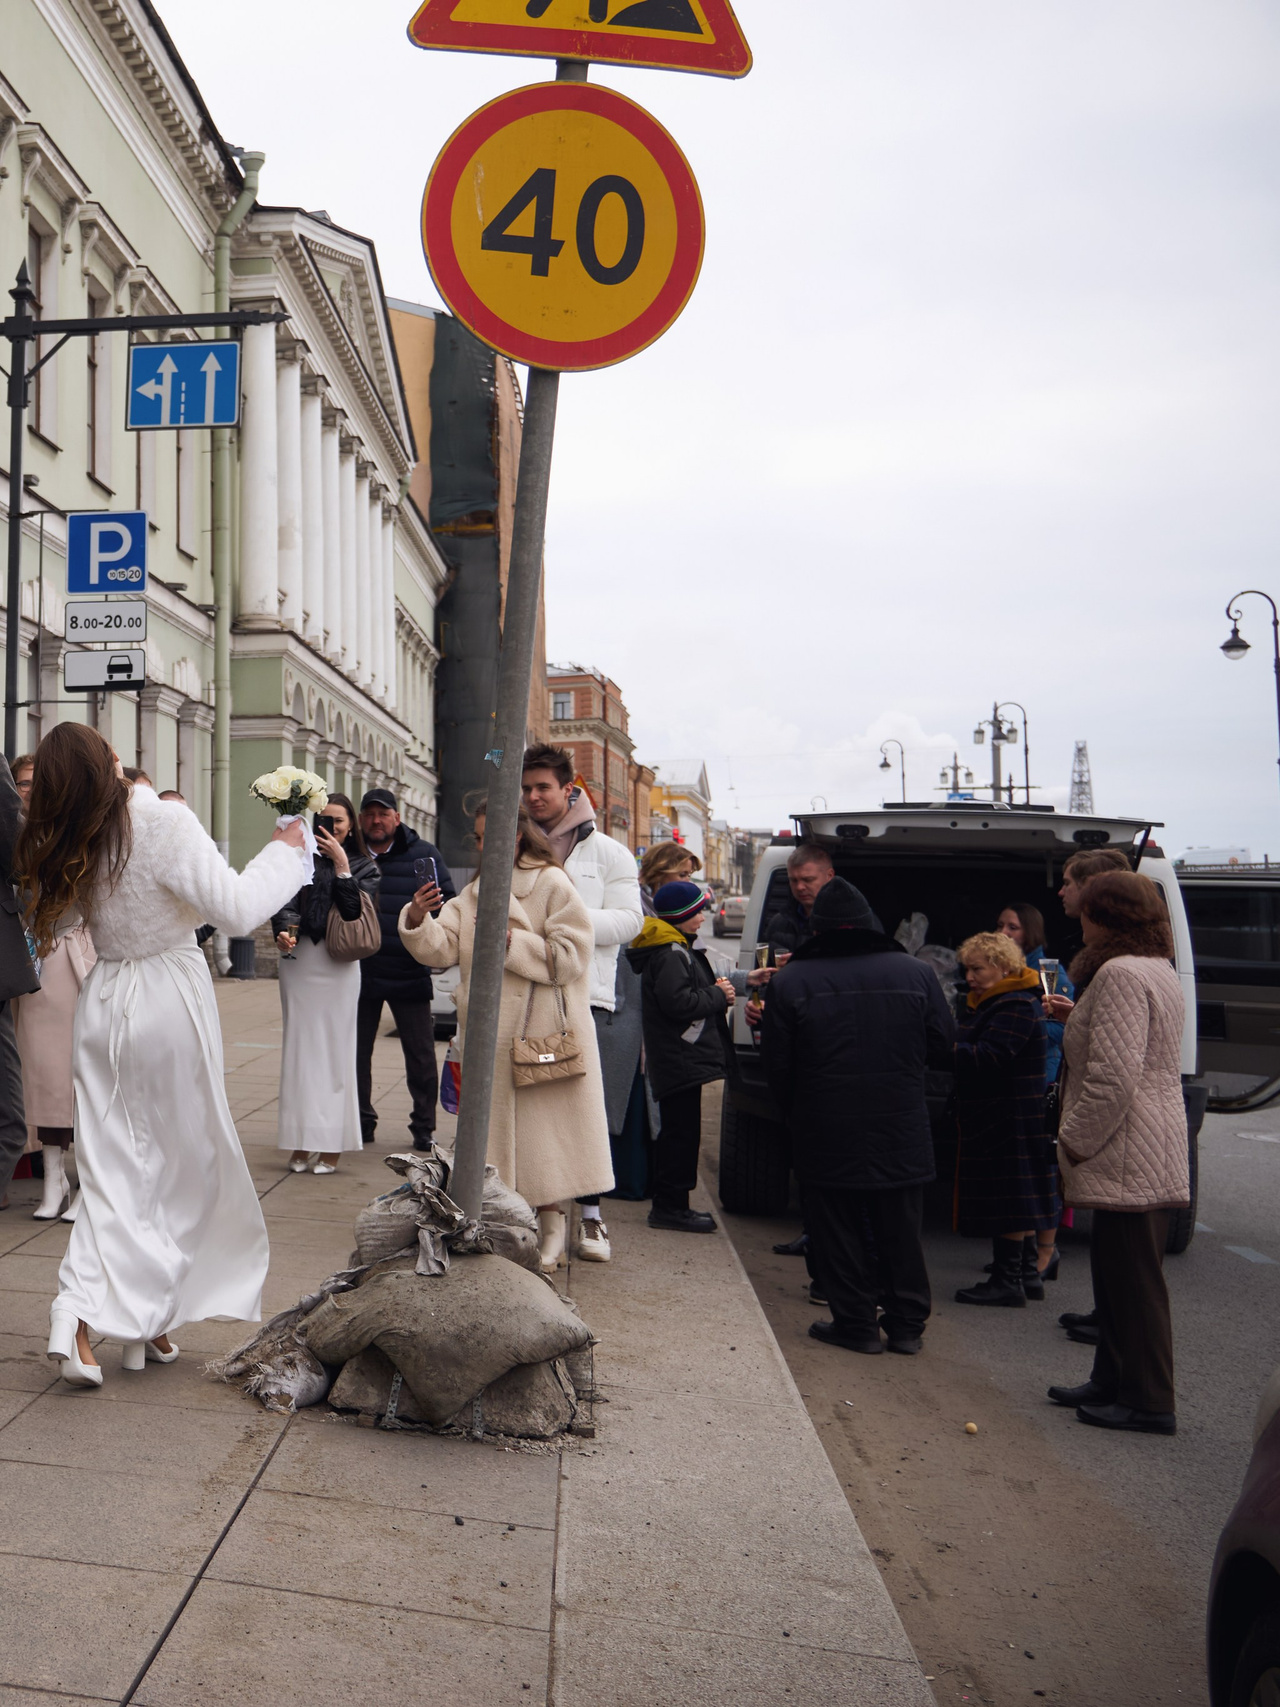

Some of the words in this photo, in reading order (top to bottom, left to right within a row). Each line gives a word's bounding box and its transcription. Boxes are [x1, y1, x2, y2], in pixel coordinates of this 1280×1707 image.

[481, 168, 645, 285] 40
[89, 522, 132, 584] P
[118, 570, 126, 578] 15
[128, 569, 141, 579] 20
[69, 615, 142, 630] 8.00-20.00
